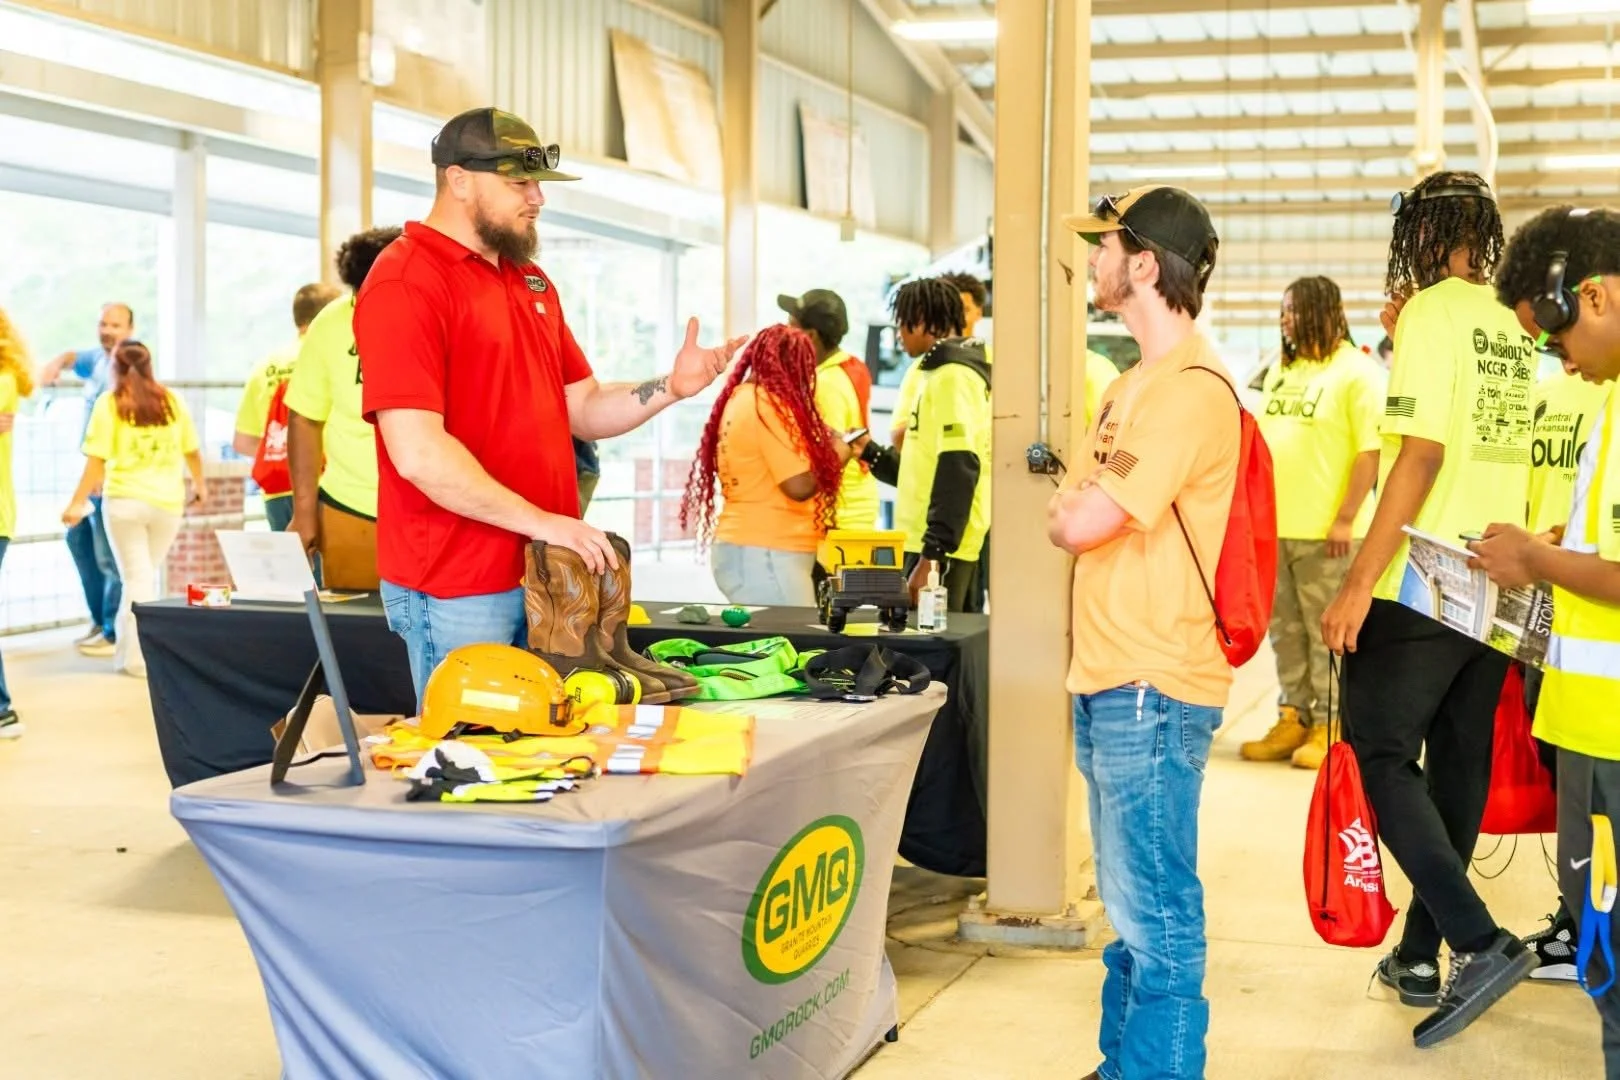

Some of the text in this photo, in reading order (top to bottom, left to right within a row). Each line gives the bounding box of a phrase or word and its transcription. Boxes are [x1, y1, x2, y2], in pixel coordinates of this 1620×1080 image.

[1477, 359, 1508, 378] NCCR
[763, 846, 850, 944] GMQ
[750, 968, 850, 1061] GMQROCK.COM
